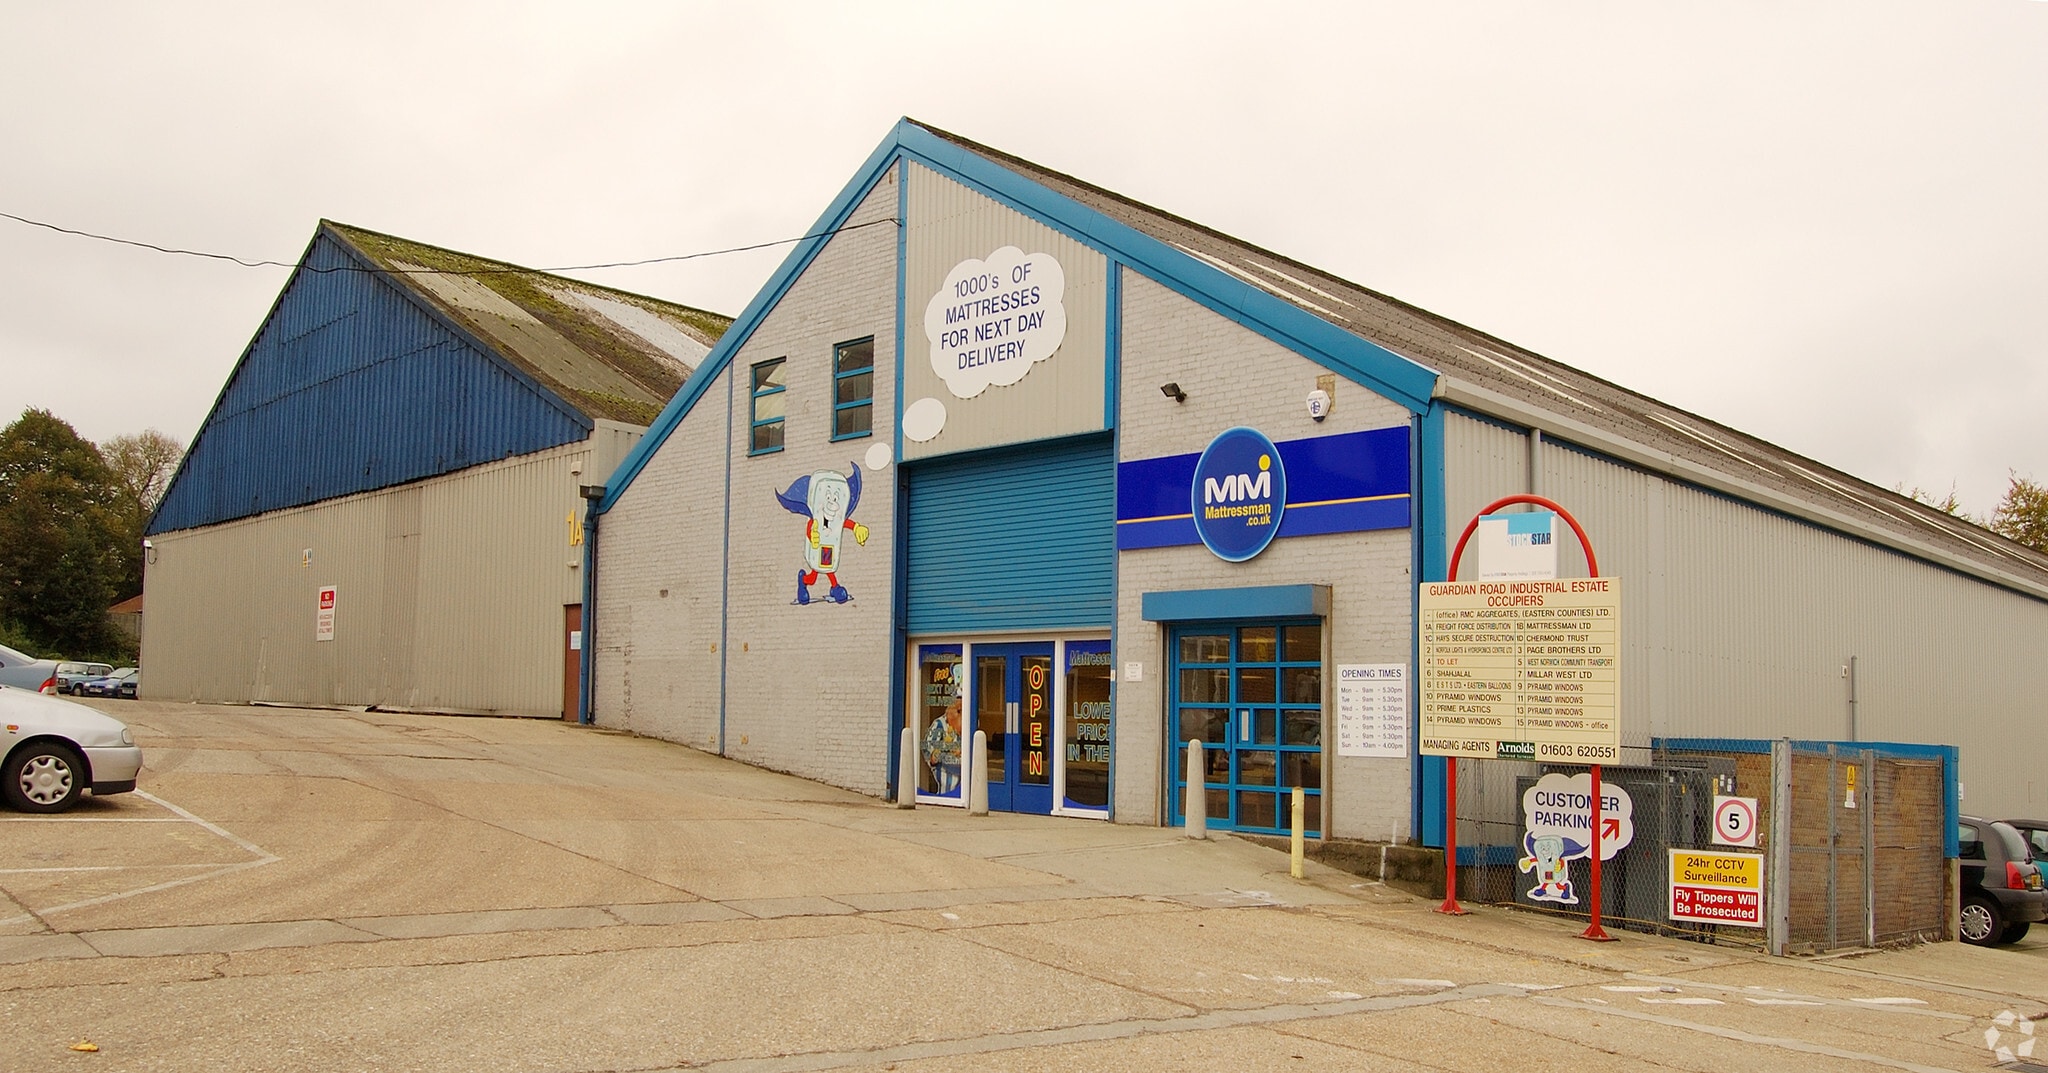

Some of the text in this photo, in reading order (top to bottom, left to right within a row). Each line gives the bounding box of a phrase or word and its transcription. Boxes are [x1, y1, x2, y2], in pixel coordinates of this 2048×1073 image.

[954, 263, 1032, 298] 1000's OF
[945, 286, 1040, 325] MATTRESSES
[941, 310, 1045, 350] FOR NEXT DAY
[958, 340, 1026, 370] DELIVERY
[1205, 503, 1271, 519] Mattressman
[1246, 515, 1271, 527] .co.uk
[566, 510, 584, 546] 1A
[1430, 581, 1609, 596] GUARDIAN ROAD INDUSTRIAL ESTATE
[1488, 596, 1544, 607] OCCUPIERS
[1436, 611, 1458, 619] (office)
[1547, 646, 1586, 654] BROTHERS
[1528, 658, 1539, 666] WEST
[1540, 658, 1560, 666] NORWICH
[1561, 658, 1586, 666] COMMUNITY
[1587, 658, 1613, 666] TRANSPORT
[1341, 669, 1402, 678] OPENING TIMES
[1488, 682, 1512, 690] BALLOONS
[1527, 683, 1552, 691] PYRAMID
[1554, 683, 1583, 691] WINDOWS
[1436, 693, 1465, 701] PYRAMID
[1468, 693, 1502, 701] WINDOWS
[1527, 695, 1552, 703] PYRAMID
[1554, 696, 1584, 704] WINDOWS
[1436, 704, 1456, 712] PRIME
[1527, 707, 1552, 715] PYRAMID
[1554, 708, 1584, 716] WINDOWS
[1029, 664, 1043, 776] OPEN
[1436, 716, 1465, 724] PYRAMID
[1468, 717, 1502, 725] WINDOWS
[1527, 719, 1553, 728] PYRAMID
[1554, 720, 1584, 728] WINDOWS
[1423, 739, 1490, 752] MANAGING AGENTS
[1498, 742, 1535, 753] Arnolds
[1541, 744, 1616, 758] 01603 620551
[1067, 743, 1110, 763] IN THE
[1728, 813, 1740, 830] 5
[1687, 857, 1745, 870] 24hr CCTV
[1684, 870, 1748, 884] Surveillance
[1675, 889, 1757, 906] Fly Tippers Will
[1677, 902, 1755, 919] Be Prosecuted
